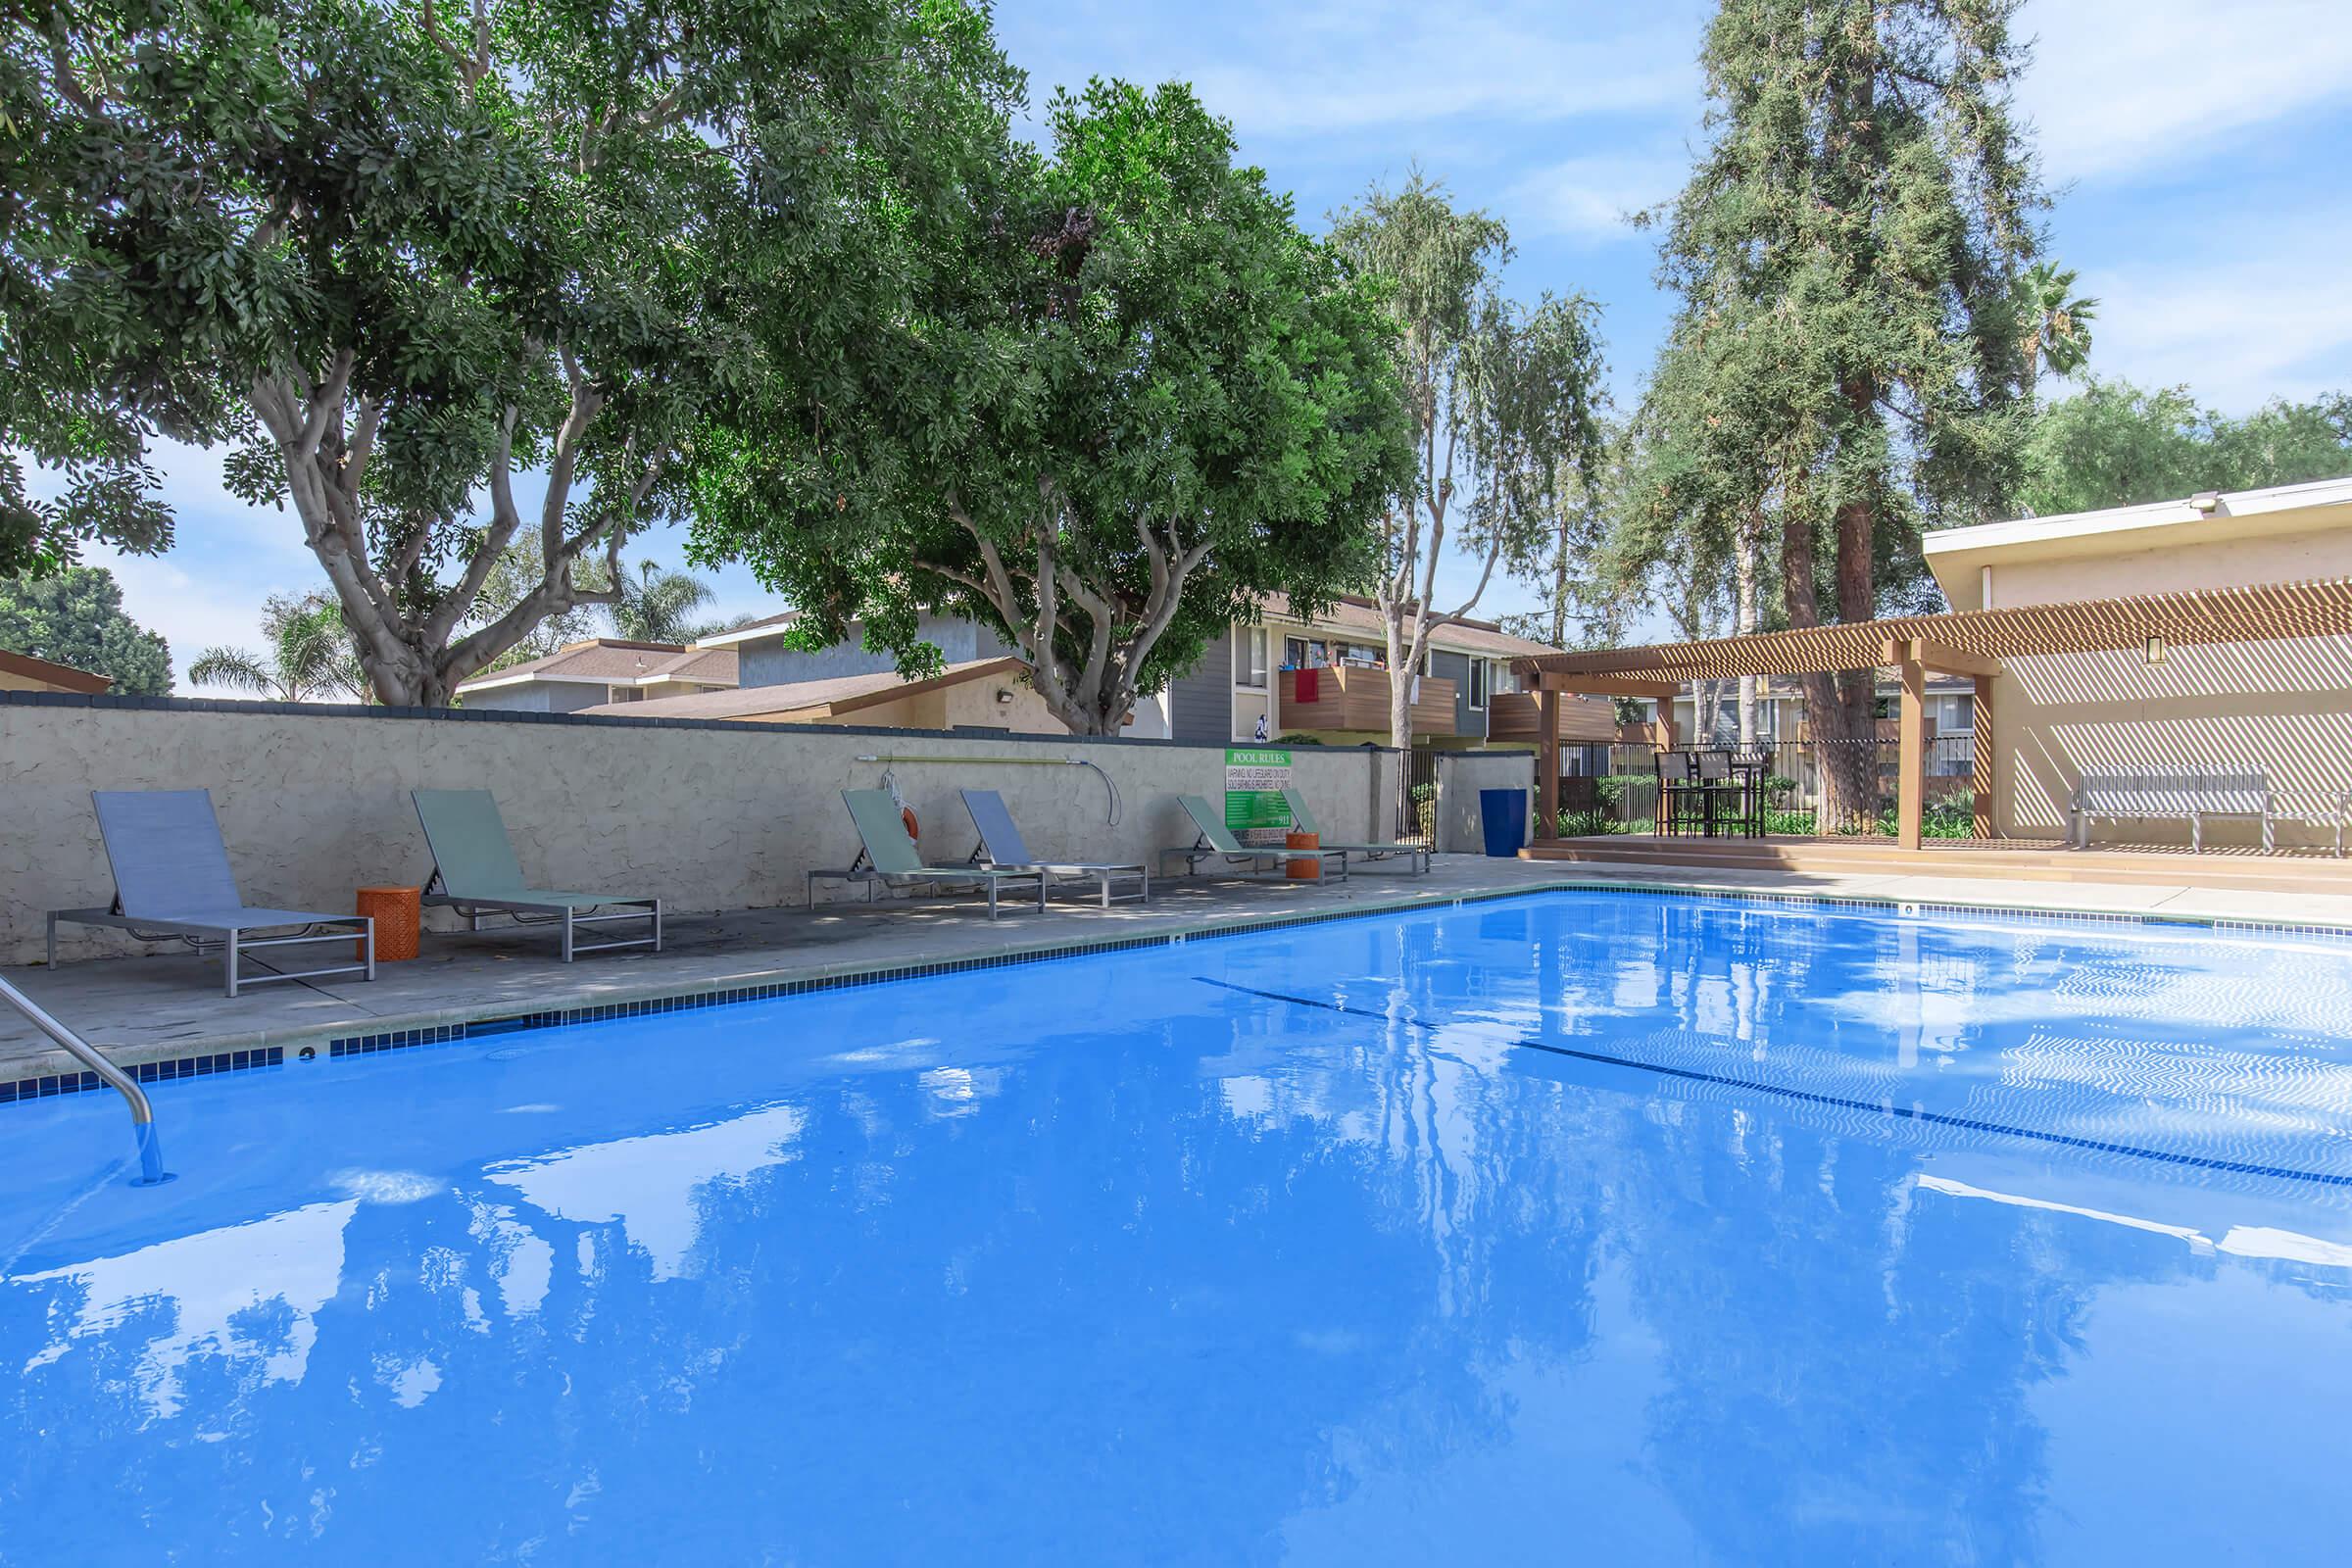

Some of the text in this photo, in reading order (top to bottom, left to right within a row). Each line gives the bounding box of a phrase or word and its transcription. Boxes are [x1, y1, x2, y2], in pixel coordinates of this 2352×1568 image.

[1233, 753, 1285, 763] POOL RULES
[1279, 815, 1289, 825] 911
